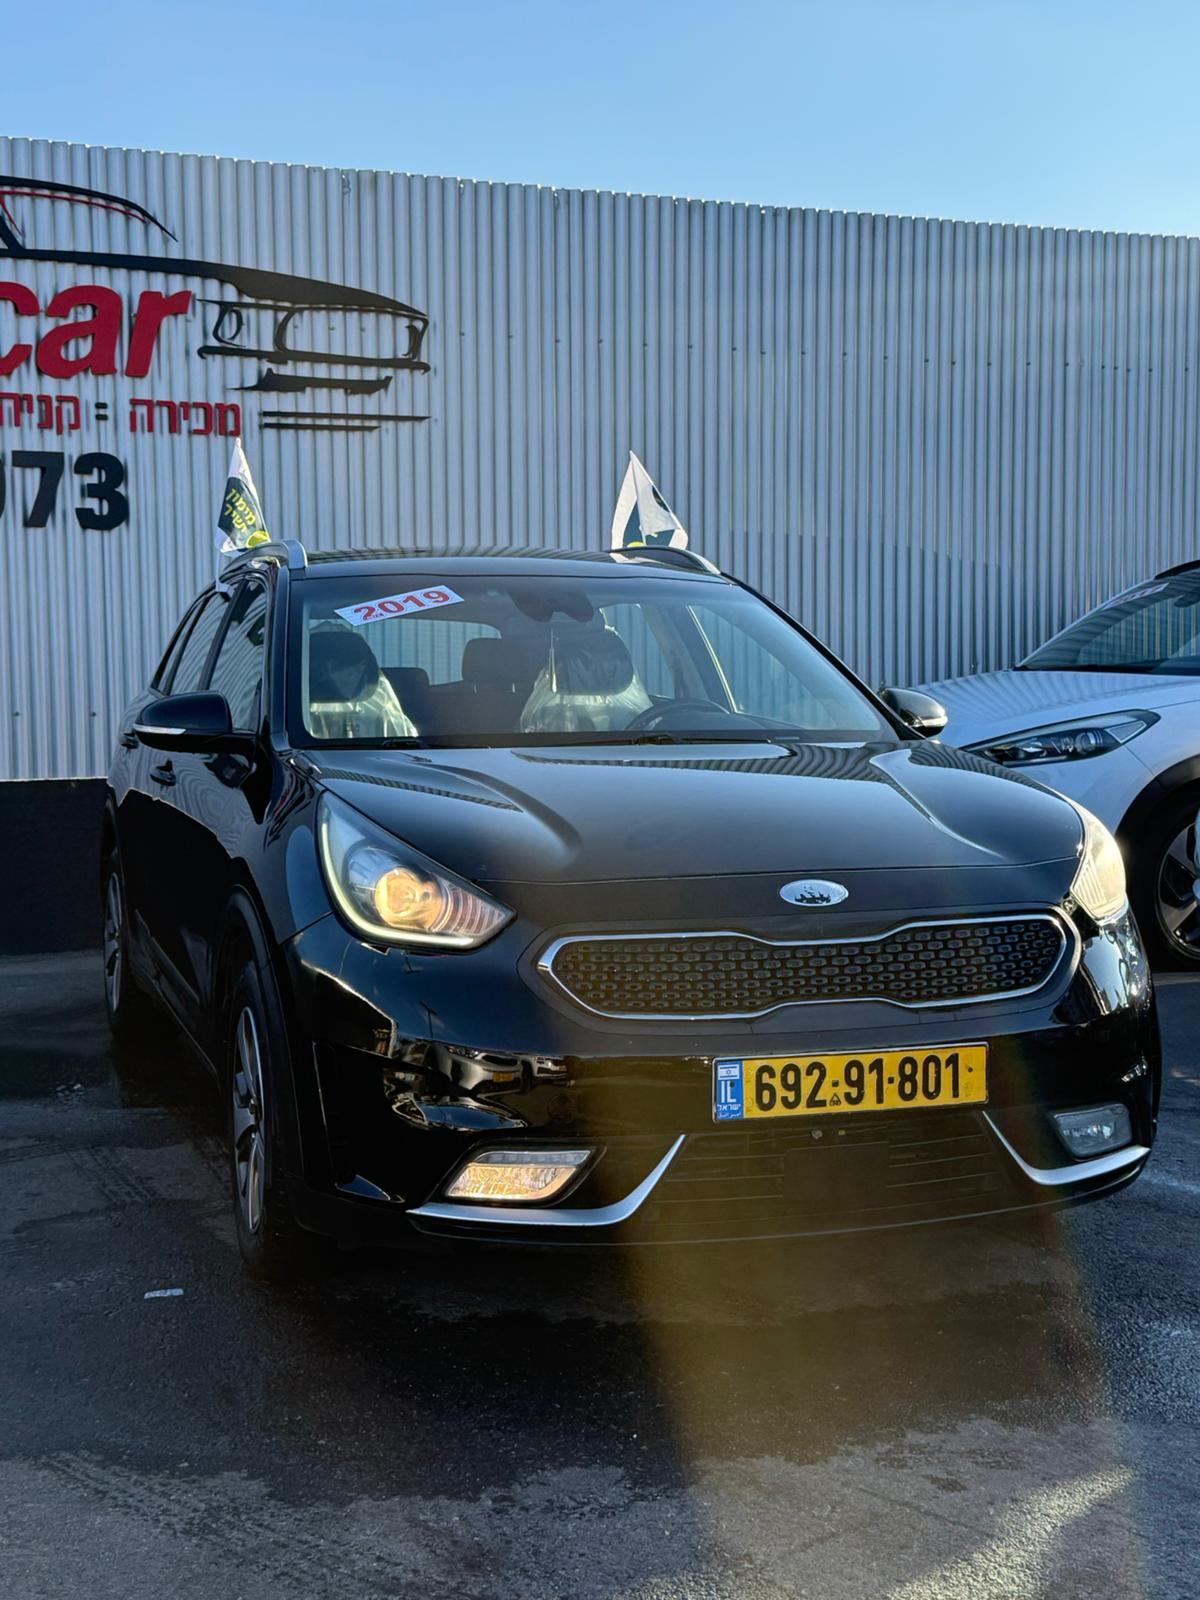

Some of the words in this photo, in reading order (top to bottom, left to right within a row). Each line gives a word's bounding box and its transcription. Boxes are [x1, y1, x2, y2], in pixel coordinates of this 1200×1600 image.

[130, 397, 241, 436] מכירה
[0, 450, 129, 530] 73
[226, 488, 256, 525] מימון
[354, 590, 450, 621] 2019
[721, 1080, 736, 1103] IL
